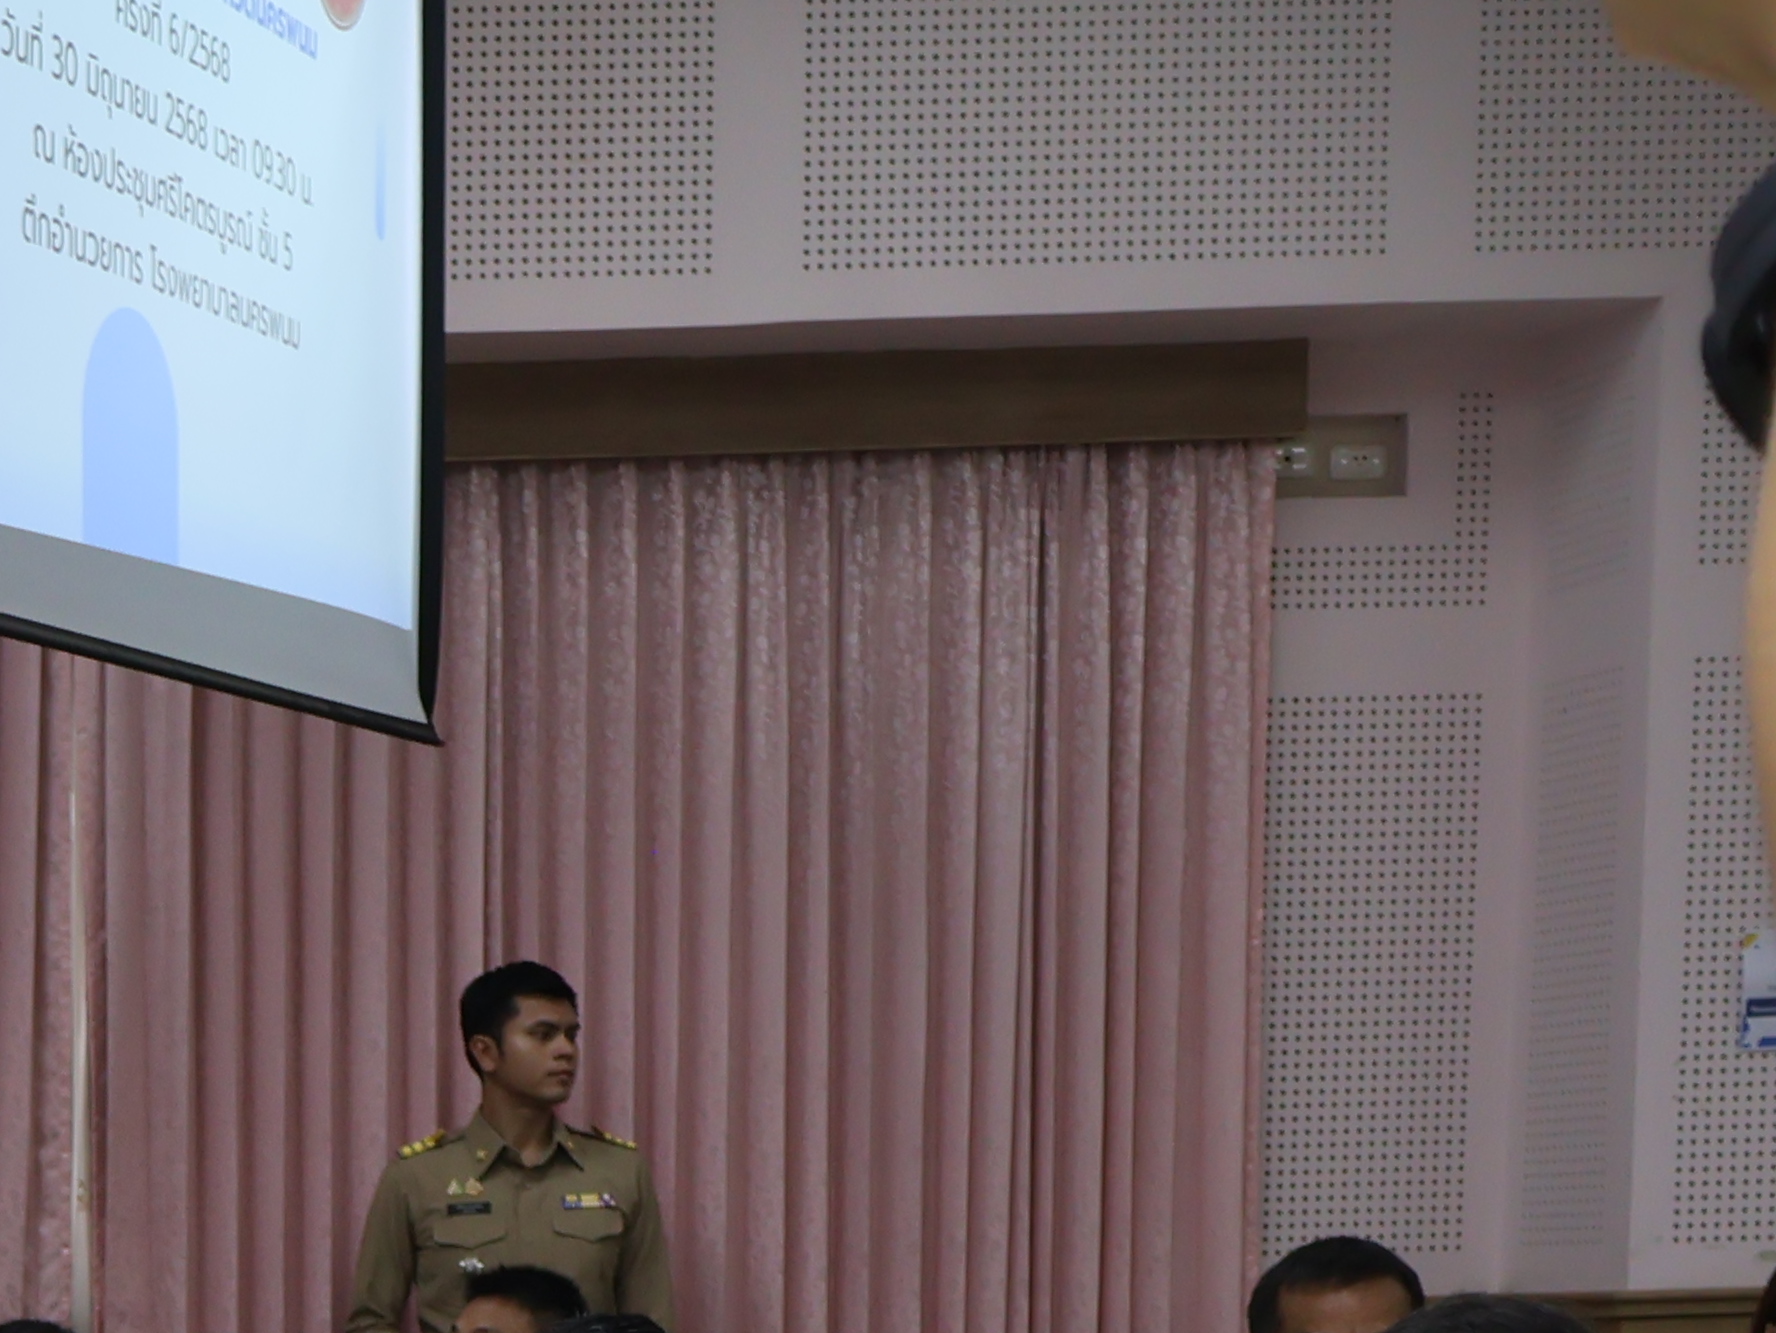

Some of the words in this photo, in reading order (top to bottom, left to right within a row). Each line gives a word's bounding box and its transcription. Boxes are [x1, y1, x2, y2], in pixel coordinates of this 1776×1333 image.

[0, 7, 43, 71] วันที่
[51, 33, 79, 87] 30
[86, 53, 158, 126] มิถุนายน
[165, 90, 209, 152] 2568
[214, 126, 246, 170] เวลา
[169, 12, 230, 84] 6/2568
[22, 193, 144, 285] ตึกอำนวยการ
[149, 243, 301, 350] โรงพยาบาลนครพนม
[33, 124, 55, 165] ณ
[63, 123, 254, 255] ห้องประชุมศรีโคตรบูรณ์
[283, 231, 294, 271] 5
